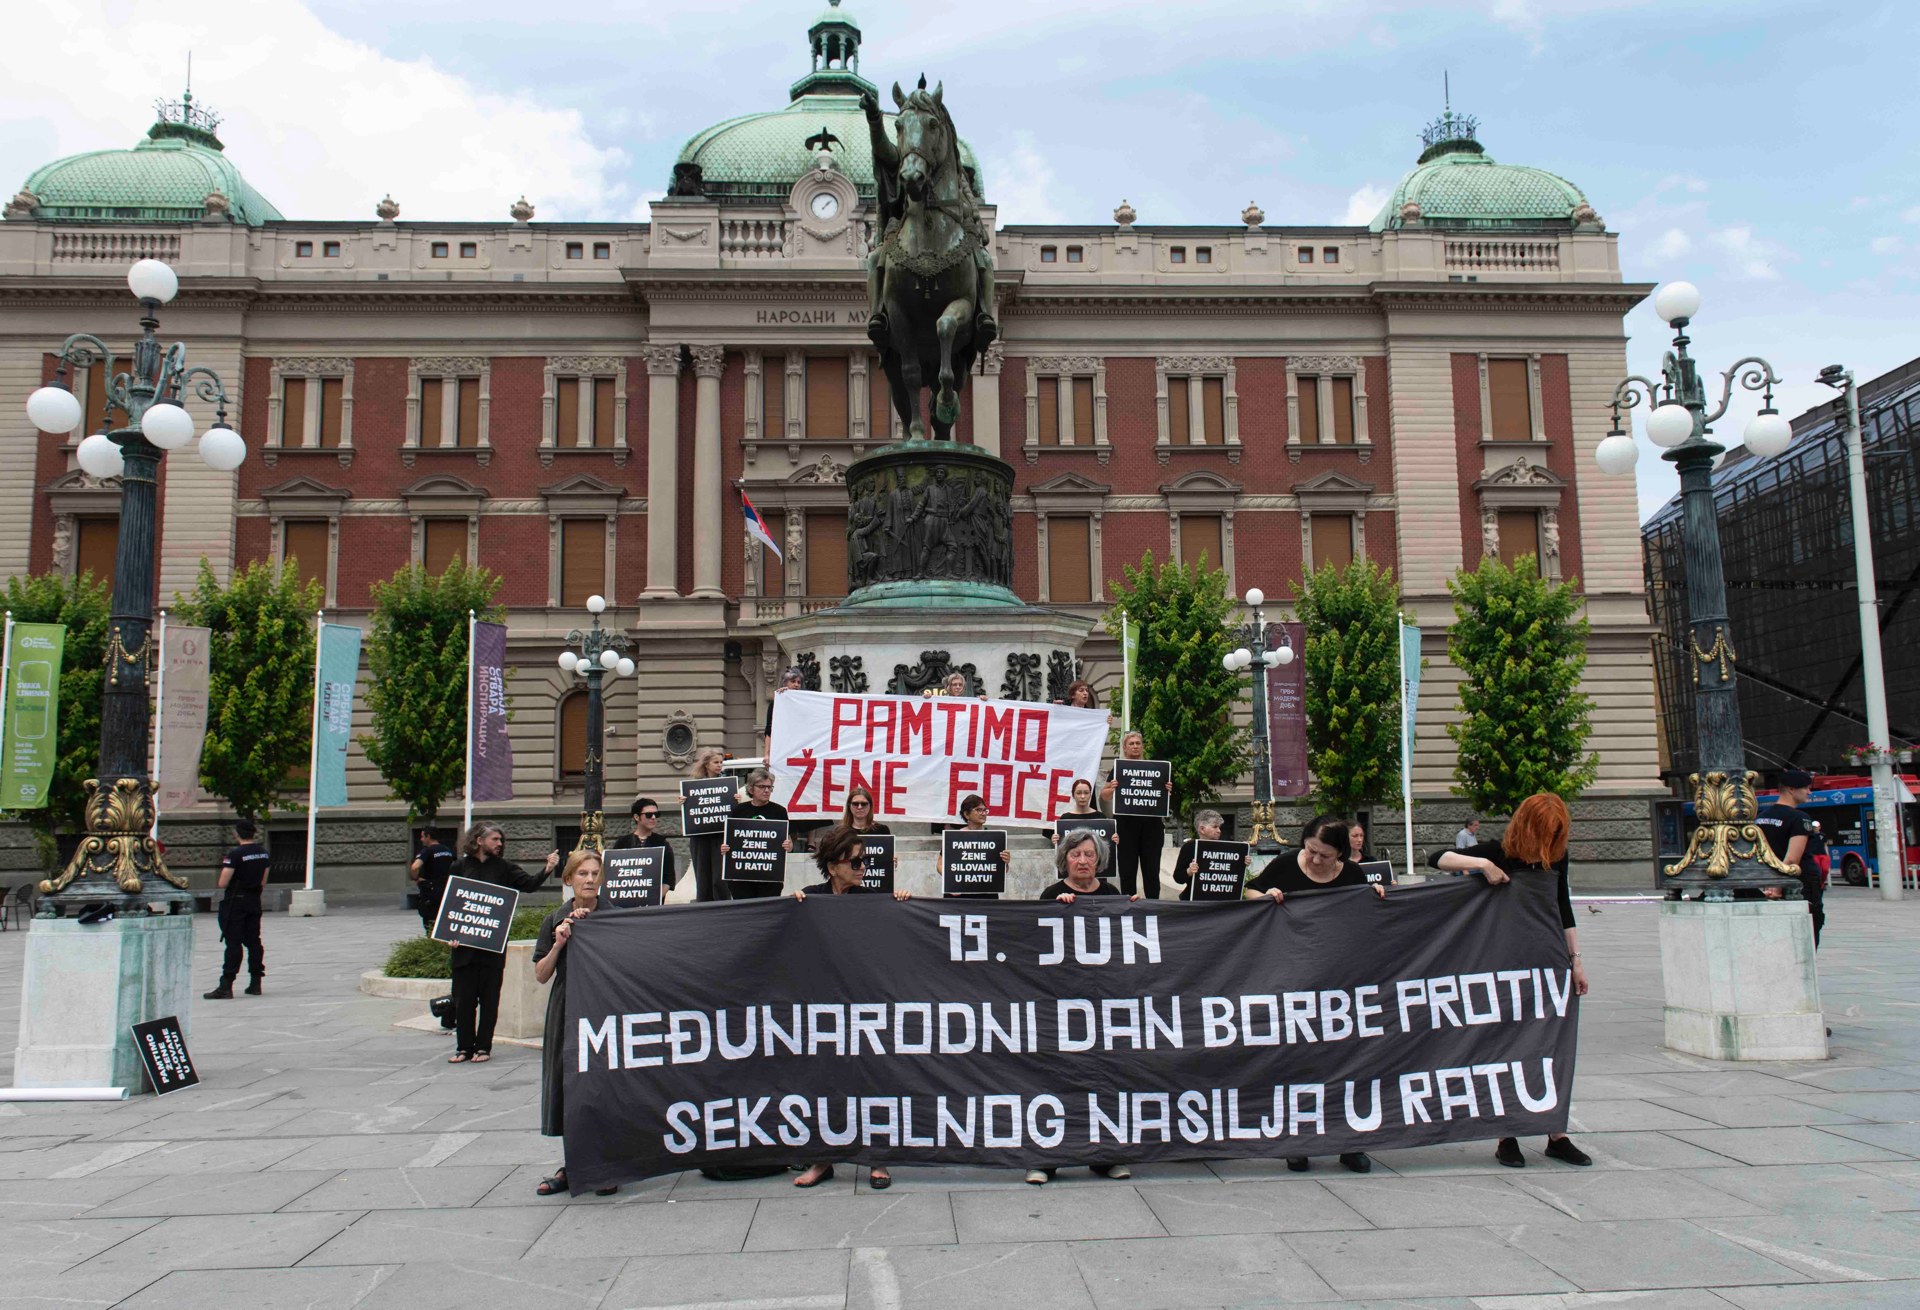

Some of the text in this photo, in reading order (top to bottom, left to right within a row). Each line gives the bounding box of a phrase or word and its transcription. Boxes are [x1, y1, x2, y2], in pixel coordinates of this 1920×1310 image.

[756, 310, 835, 323] НАРОДНИ
[488, 666, 498, 714] СТВАРА
[830, 698, 1049, 763] PAMTIMO
[1123, 769, 1161, 778] PAMTIMO
[787, 748, 909, 816] ŽENE
[1130, 779, 1152, 787] ŽENE
[690, 786, 728, 796] PAMTIMO
[947, 762, 1074, 822] FOČE
[1121, 788, 1161, 797] SILOVANE
[698, 796, 721, 805] ŽENE
[1133, 798, 1157, 807] RATU!
[689, 805, 731, 815] SILOVANE
[703, 815, 728, 824] RATU!
[734, 830, 777, 838] PAMTIMO
[742, 839, 767, 849] ŽENE
[952, 841, 996, 849] PAMTIMO
[731, 851, 777, 860] SILOVANE
[961, 851, 986, 861] ŽENE
[1202, 851, 1240, 861] PAMTIMO
[610, 858, 652, 867] PAMTIMO
[735, 862, 772, 871] U RATU!
[950, 863, 997, 872] SILOVANE
[1209, 861, 1231, 871] ŽENE
[618, 868, 642, 877] ŽENE
[1200, 872, 1238, 882] SILOVANE
[955, 874, 992, 882] U RATU!
[606, 879, 652, 888] SILOVANE
[1202, 884, 1233, 892] U RATU!
[456, 888, 504, 906] PAMTIMO
[620, 890, 648, 898] RATU!
[462, 900, 492, 915] ŽENE
[448, 911, 500, 928] SILOVANE
[450, 923, 492, 938] U RATU!
[939, 914, 1162, 966] 19. JUN
[578, 968, 1572, 1073] MEĐUNARODNI DAN BORBE PROTIV
[162, 1027, 185, 1080] SILOVANE
[146, 1034, 169, 1084] PAMTIMO
[183, 1065, 190, 1074] U
[662, 1057, 1558, 1154] SEKSUALNOG NASILJA U RATU
